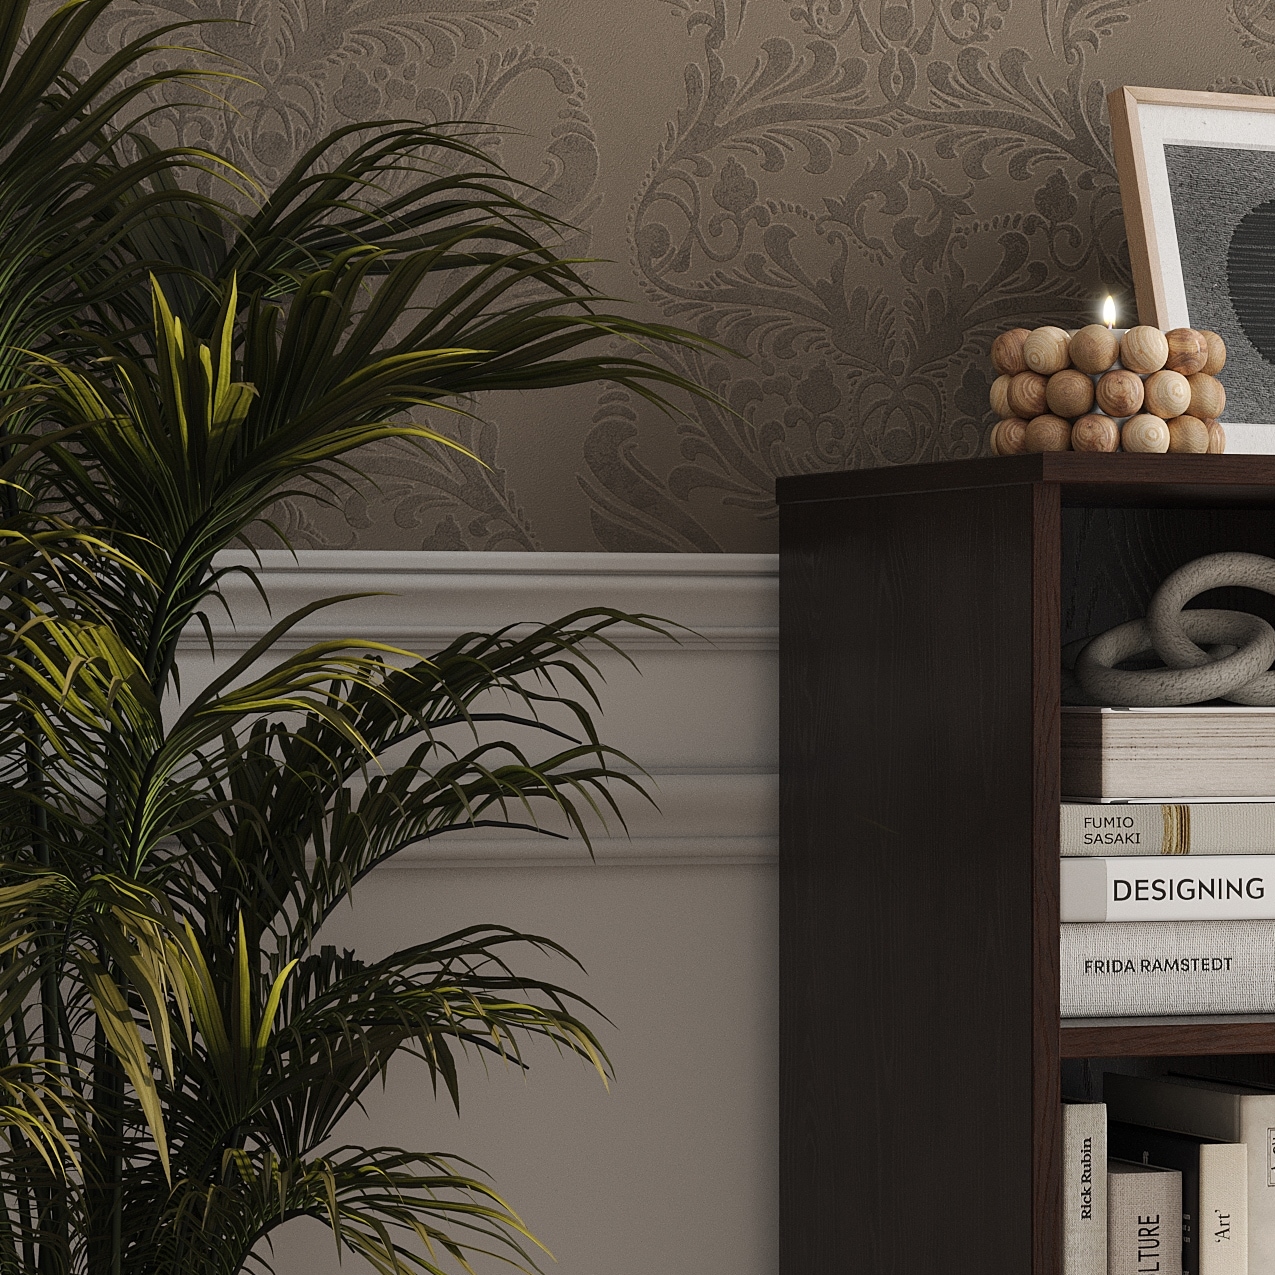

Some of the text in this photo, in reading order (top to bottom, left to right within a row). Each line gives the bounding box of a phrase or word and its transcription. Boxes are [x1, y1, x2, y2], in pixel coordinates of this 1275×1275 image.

[1084, 817, 1134, 829] FUMIO
[1084, 833, 1141, 845] SASAKI
[1113, 877, 1265, 902] DESIGNING
[1084, 957, 1233, 975] FRIDA RAMSTEDT
[1080, 1137, 1092, 1220] Rick Rubin
